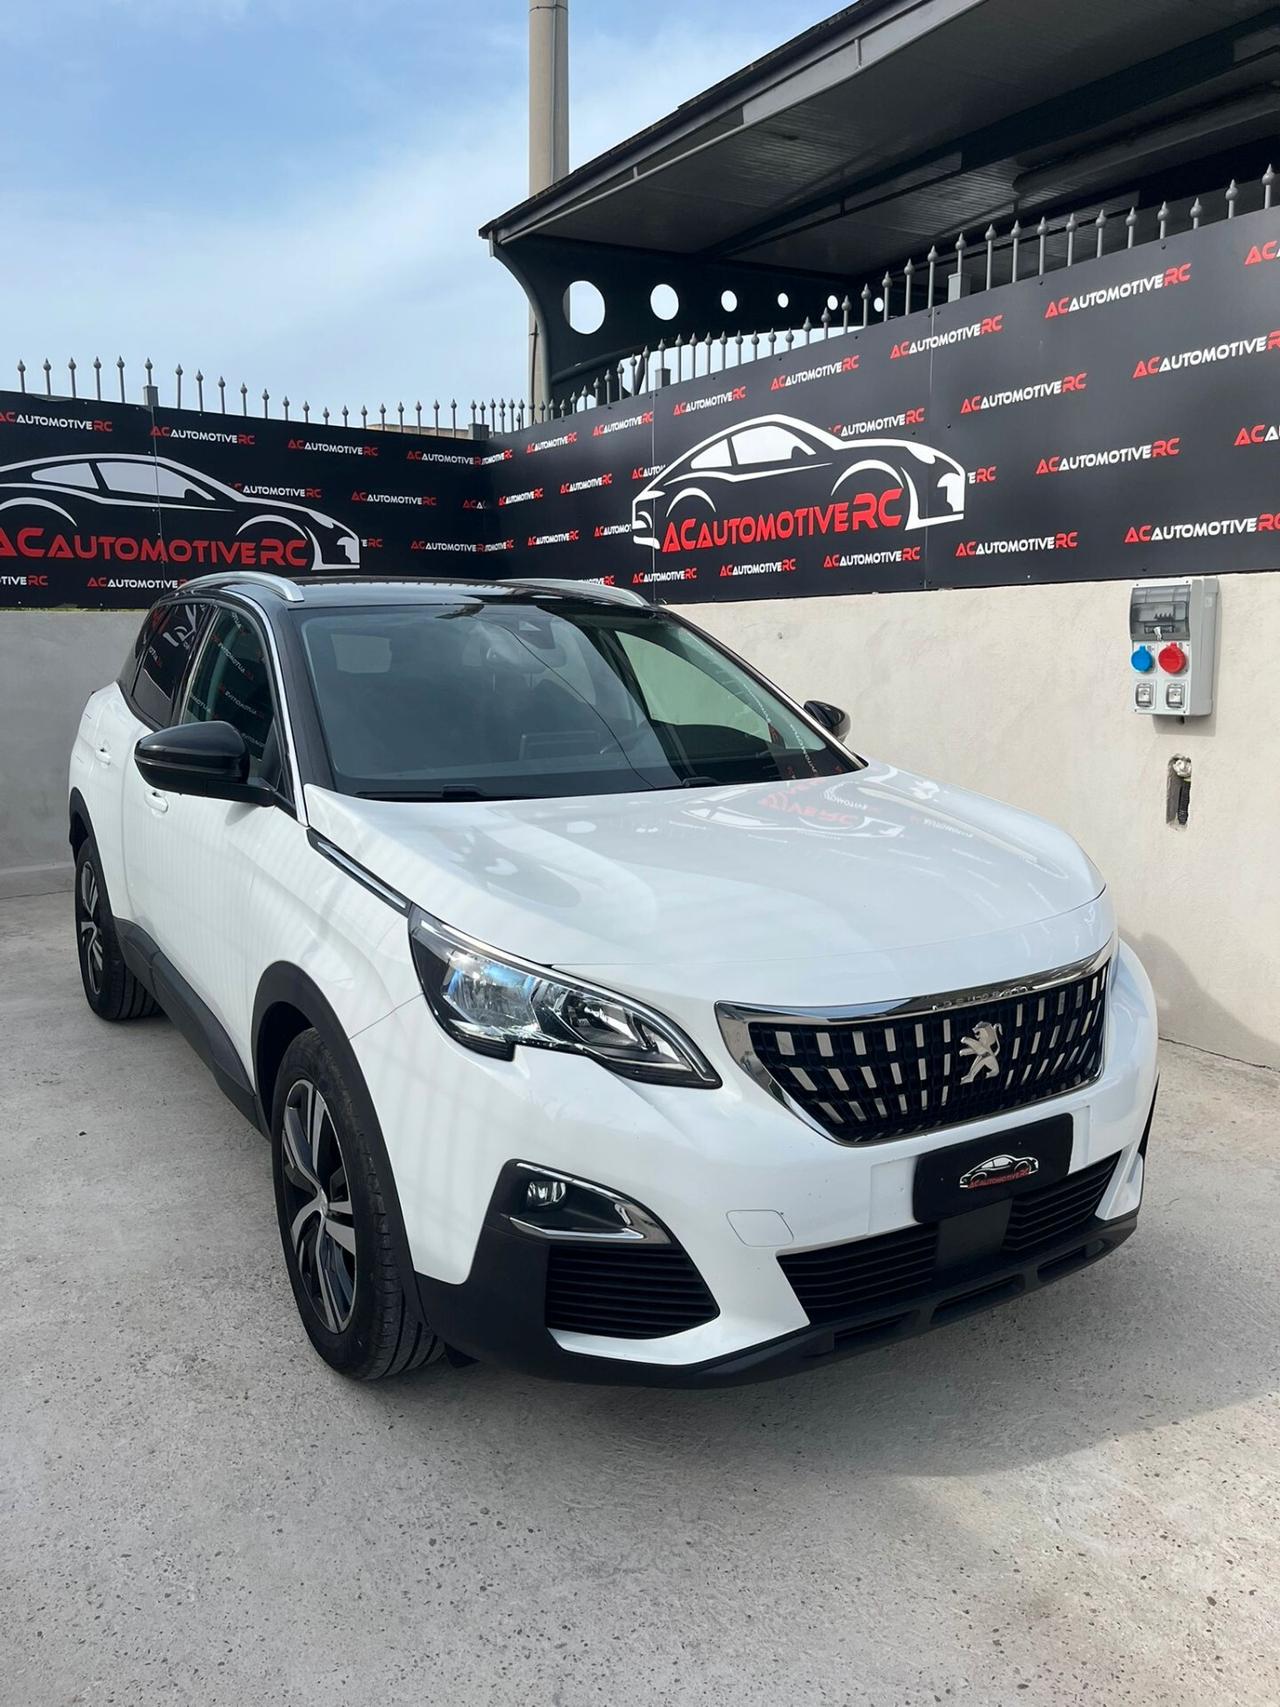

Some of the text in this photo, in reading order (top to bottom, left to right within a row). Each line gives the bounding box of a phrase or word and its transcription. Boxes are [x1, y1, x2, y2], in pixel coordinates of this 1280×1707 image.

[1132, 330, 1280, 379] ACAUTOMOTIVER
[407, 450, 481, 465] ACAUTOMOTIVER
[411, 540, 484, 552] ACAUTOMOTIVER
